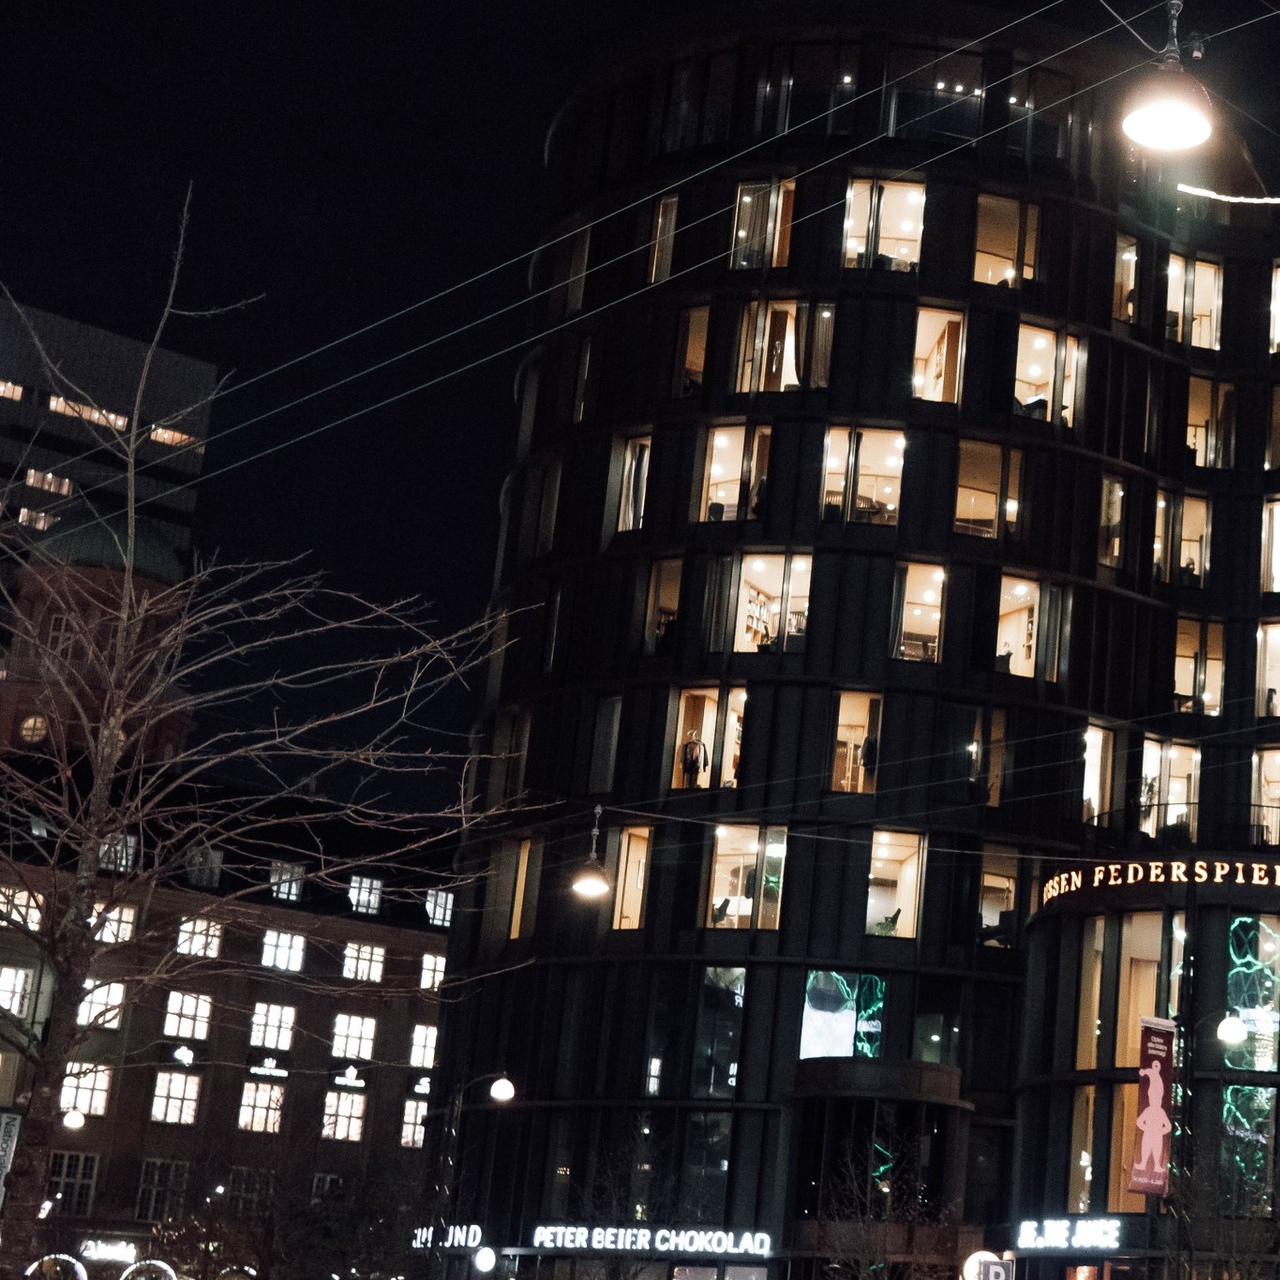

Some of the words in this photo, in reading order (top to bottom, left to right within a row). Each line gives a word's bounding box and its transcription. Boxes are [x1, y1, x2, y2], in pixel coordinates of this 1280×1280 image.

[533, 1226, 589, 1248] PETER
[592, 1227, 651, 1250] BEIER
[655, 1229, 771, 1255] CHOKOLAD
